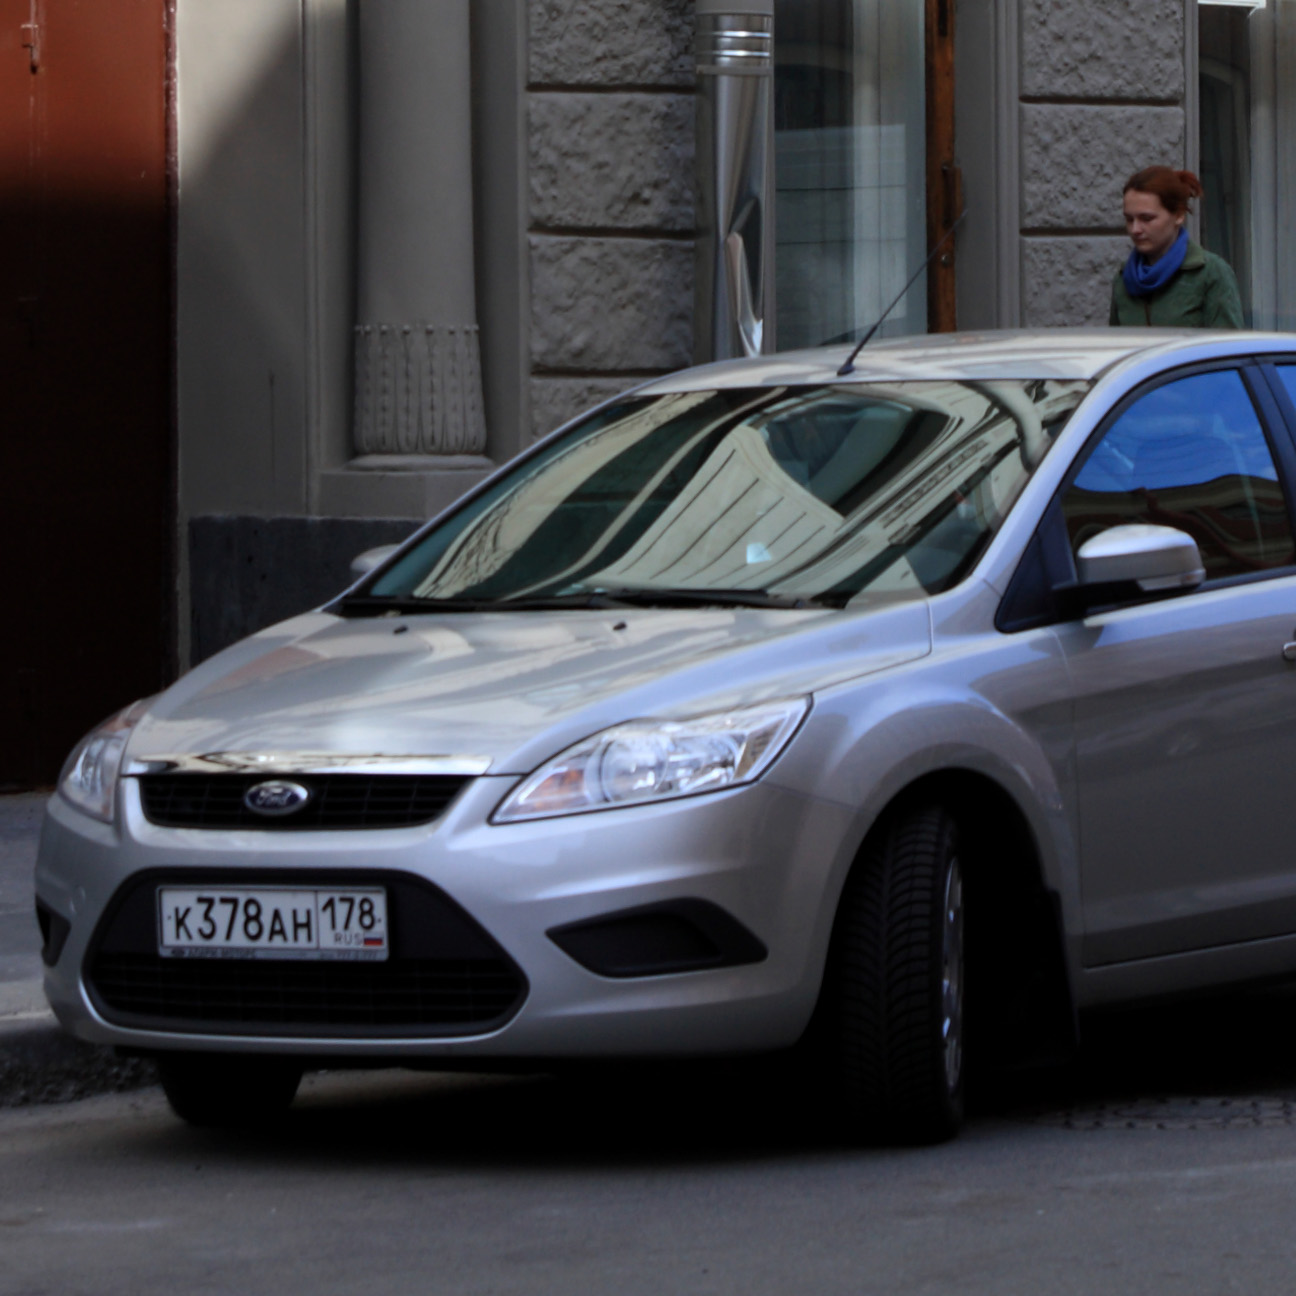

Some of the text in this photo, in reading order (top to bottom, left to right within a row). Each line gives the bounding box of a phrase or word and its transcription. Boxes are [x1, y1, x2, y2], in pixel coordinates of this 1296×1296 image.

[256, 789, 292, 806] Ford
[174, 896, 375, 943] К378АН 178
[334, 932, 364, 945] RUS
